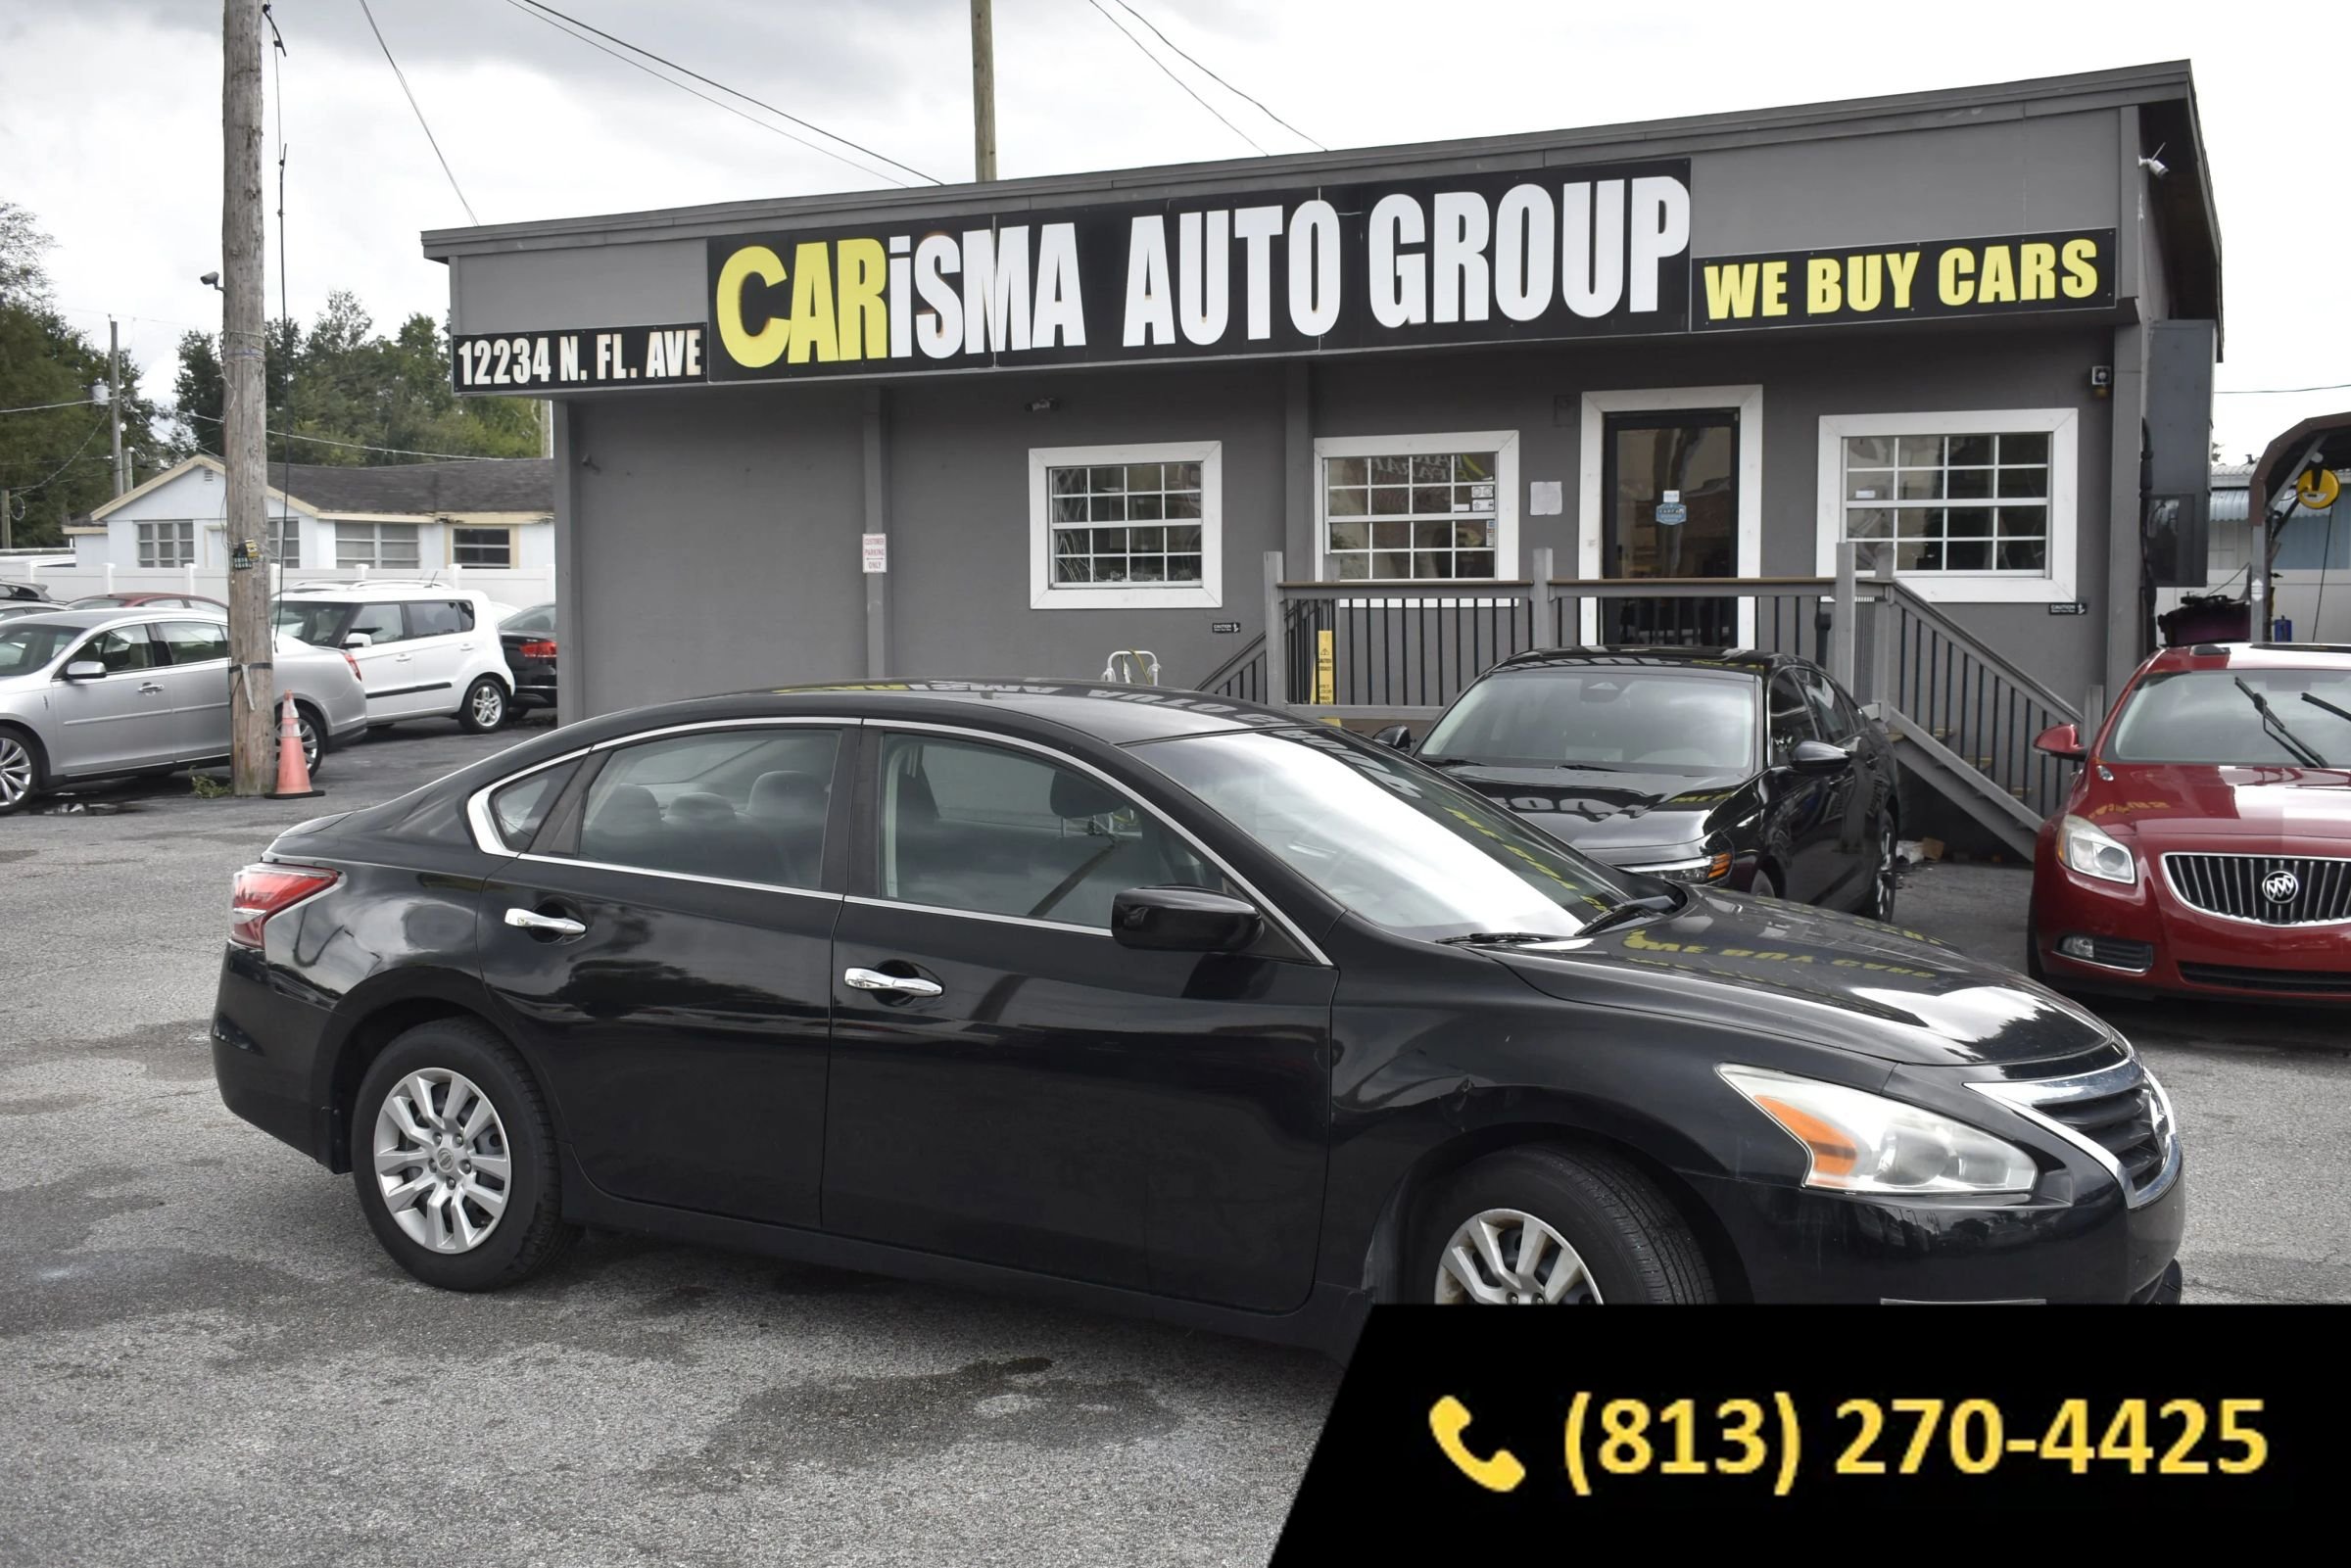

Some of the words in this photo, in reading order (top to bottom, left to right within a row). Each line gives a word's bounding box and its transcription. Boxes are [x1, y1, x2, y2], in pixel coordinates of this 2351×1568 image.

[1123, 199, 1341, 348] AUTO
[1368, 174, 1690, 329] GROUP
[1703, 261, 1788, 320] WE
[1807, 251, 1920, 312] BUY
[1938, 238, 2098, 306] CARS
[457, 337, 552, 385] 12234
[559, 336, 588, 381] N.
[597, 333, 637, 380] FL.
[646, 329, 701, 378] AVE
